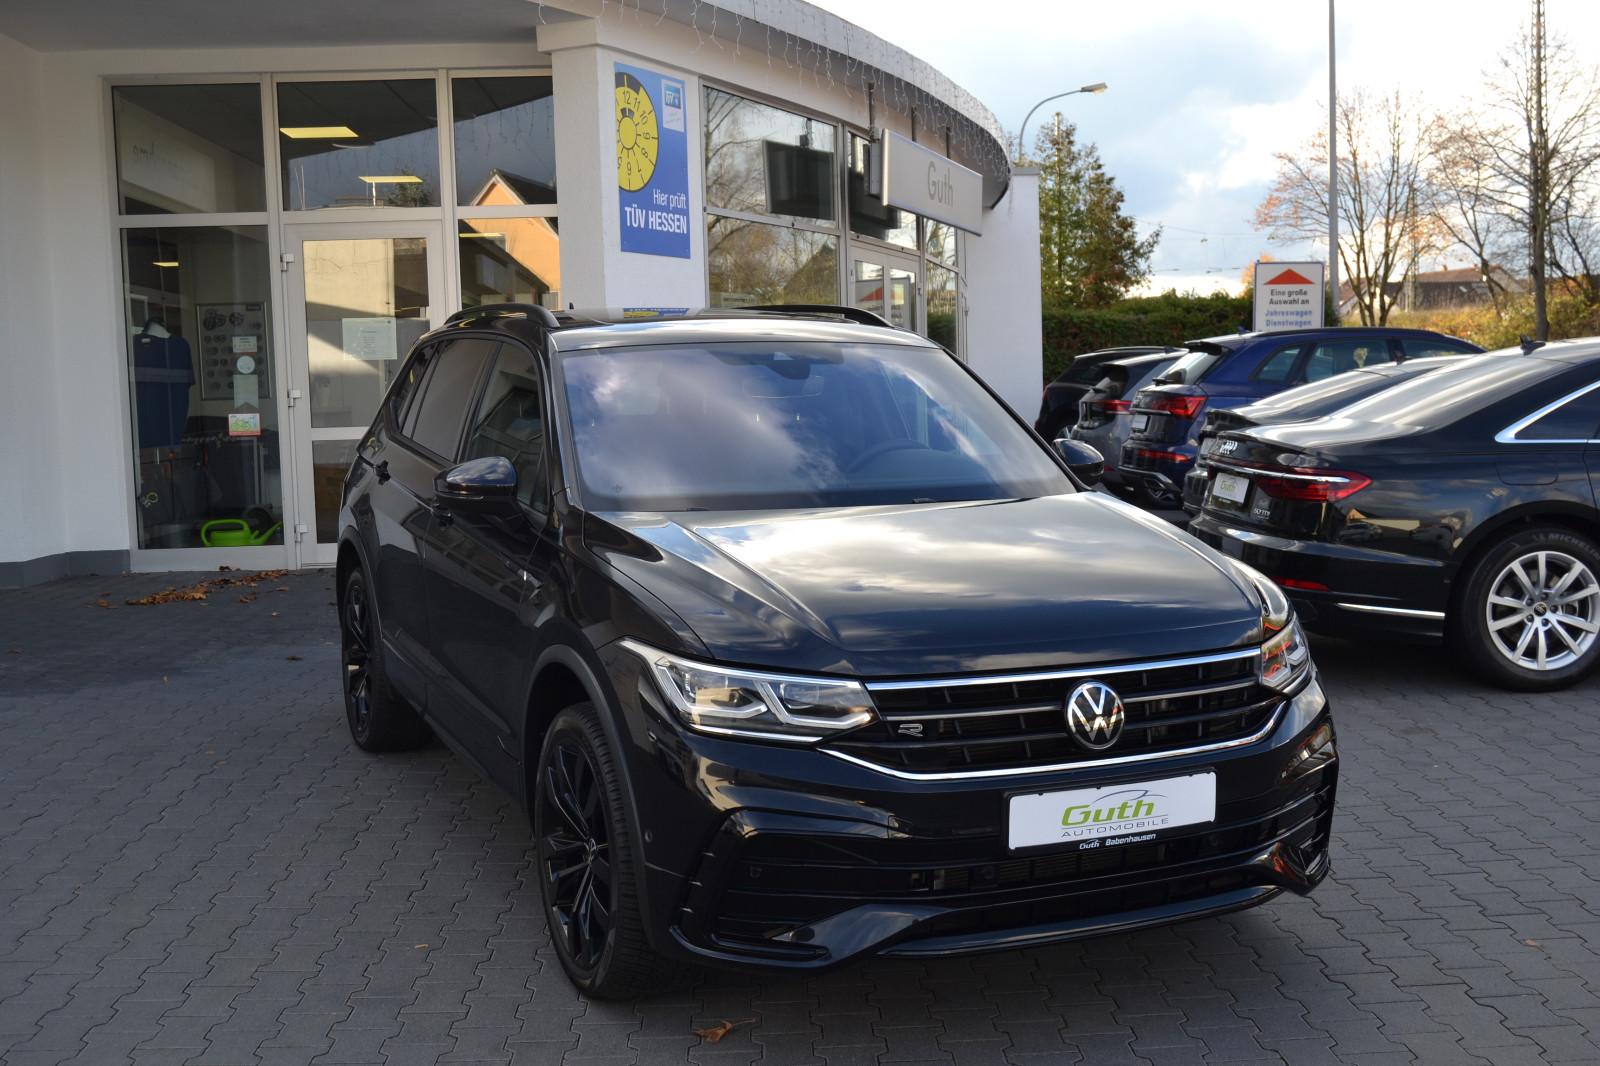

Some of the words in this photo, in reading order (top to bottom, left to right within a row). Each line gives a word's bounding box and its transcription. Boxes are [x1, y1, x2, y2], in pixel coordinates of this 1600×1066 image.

[622, 90, 631, 105] 12
[640, 112, 649, 125] 10
[641, 147, 649, 158] 8
[927, 160, 954, 208] Guth
[653, 188, 669, 207] Hier
[669, 192, 687, 210] prüft
[624, 203, 646, 229] TÜV
[648, 210, 688, 235] HESSEN
[1270, 288, 1286, 297] Eine
[1287, 288, 1308, 298] große
[1265, 310, 1312, 318] Jahreswagen
[1266, 320, 1312, 328] Dienstwagen
[1061, 799, 1155, 827] Guth
[1061, 818, 1169, 838] AUTOMOBILE
[1080, 839, 1100, 850] Guth
[1105, 833, 1157, 847] Babenhausen
